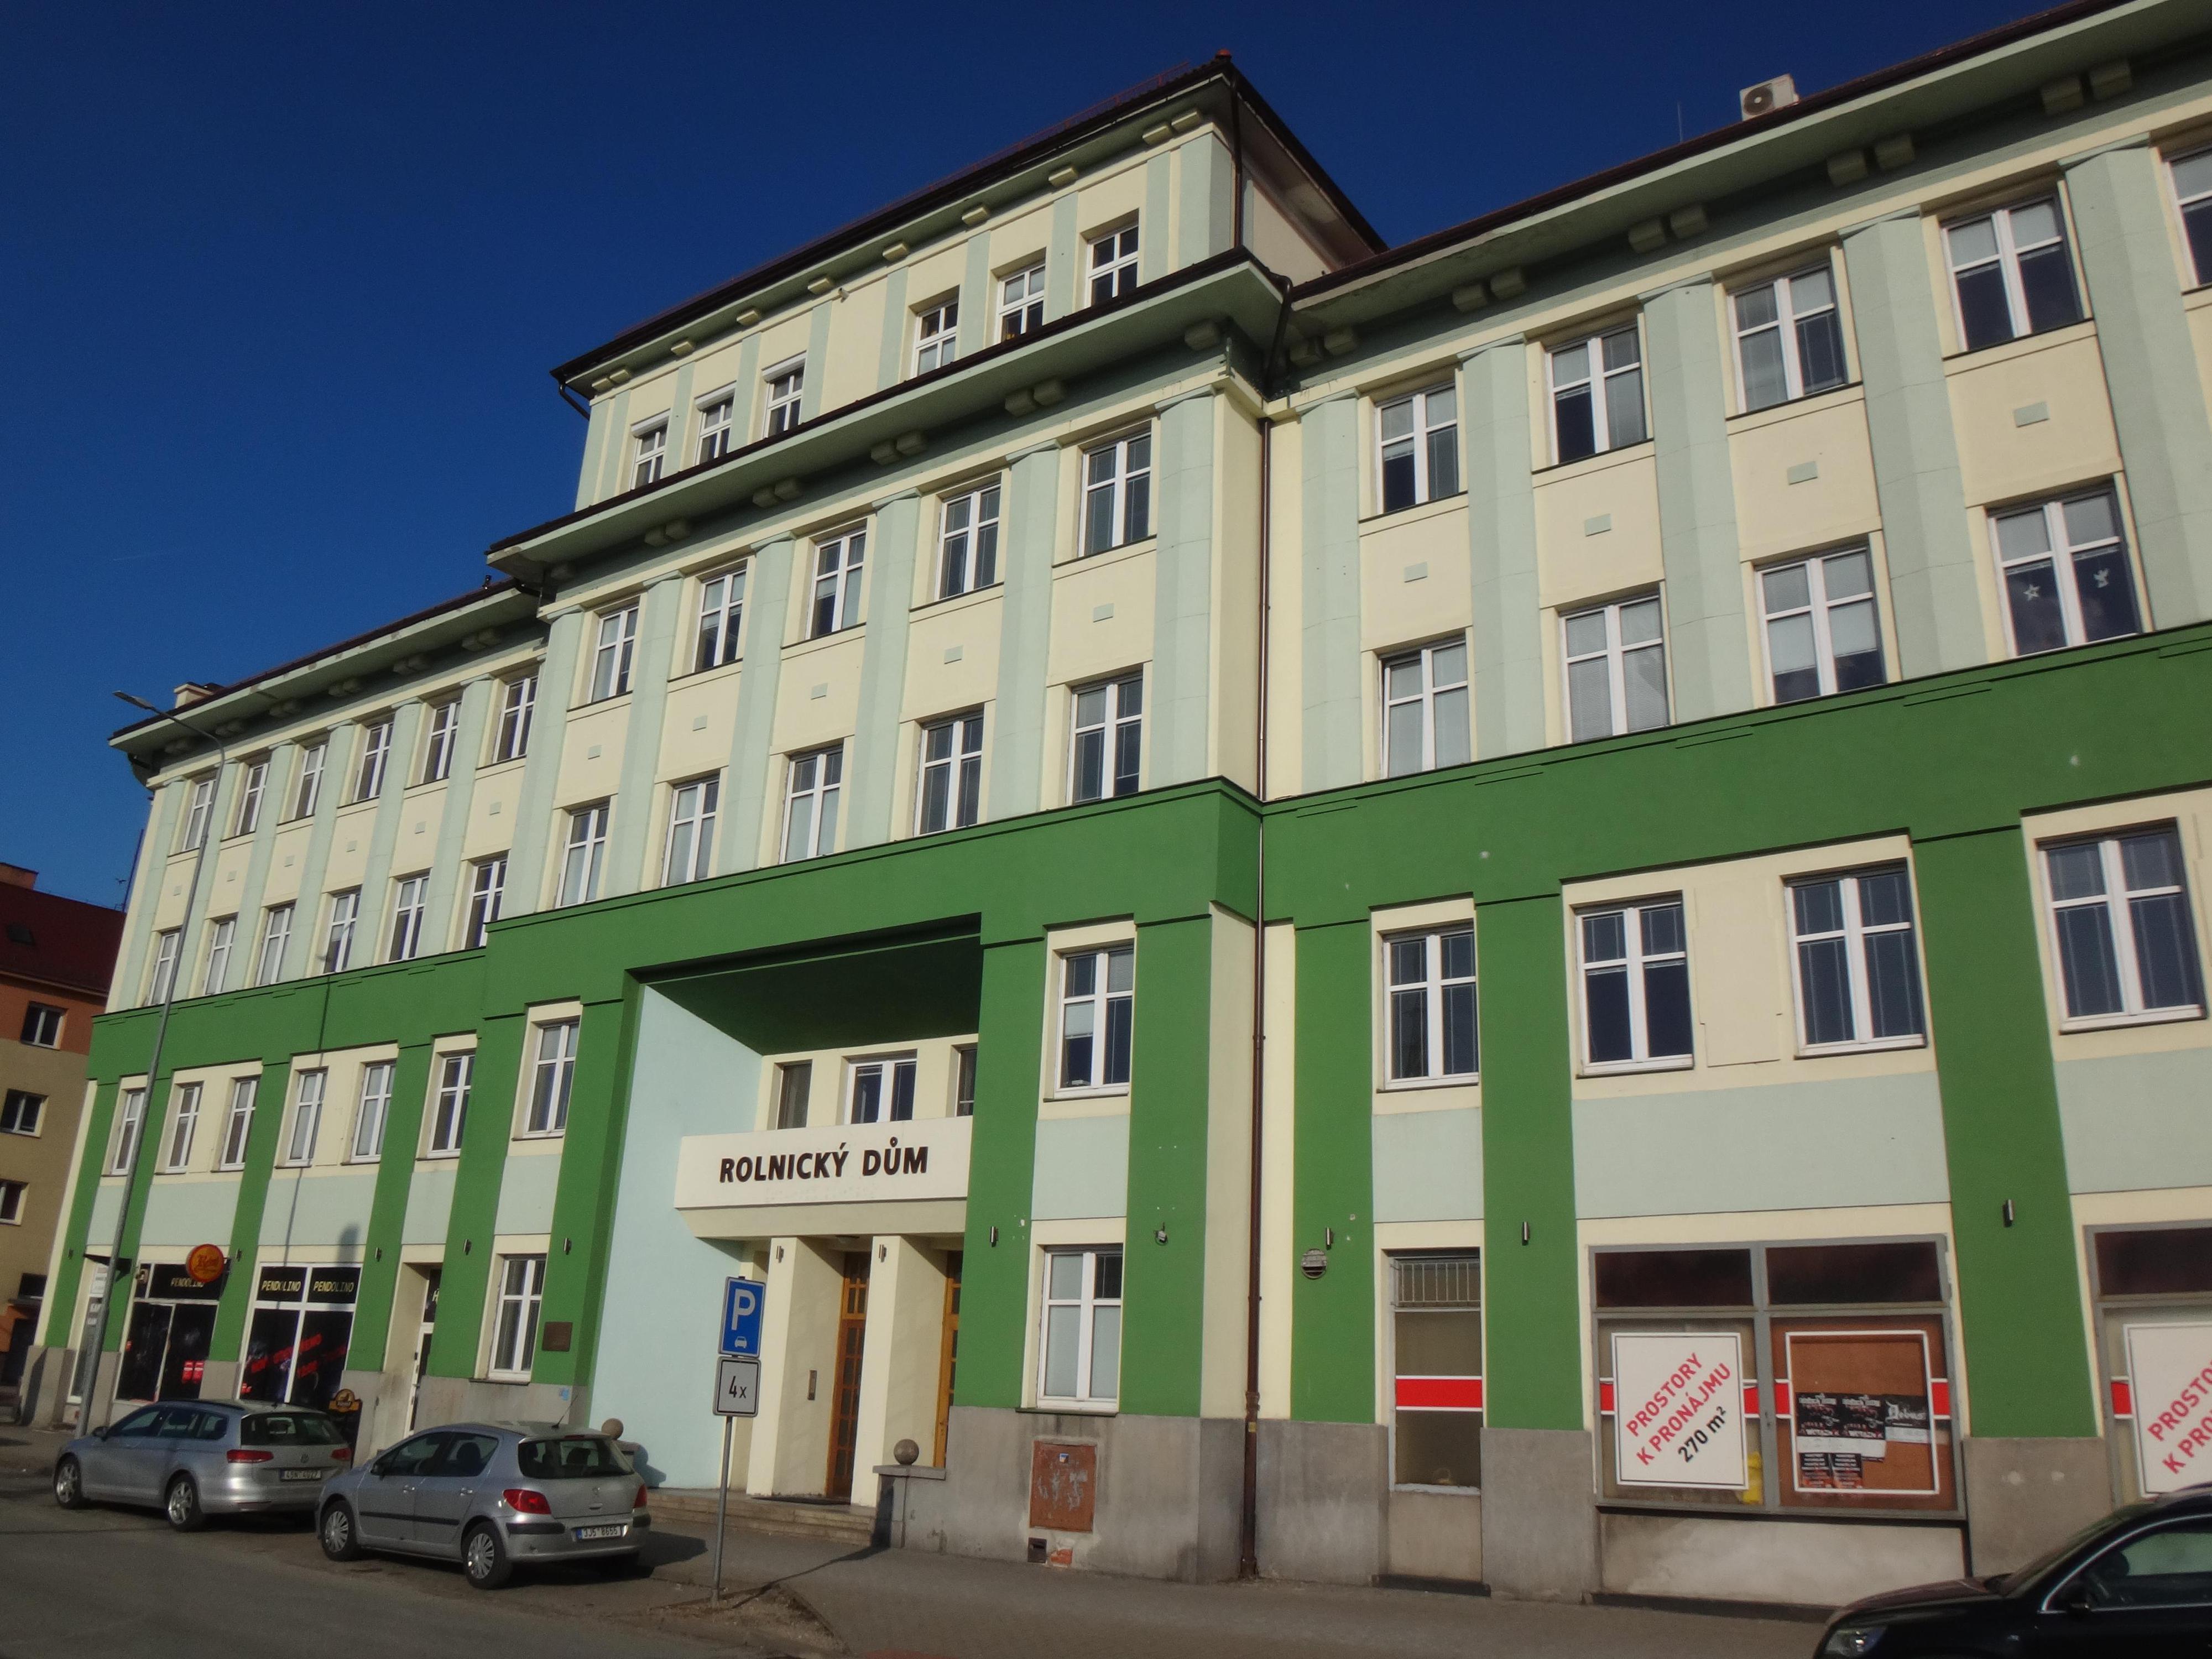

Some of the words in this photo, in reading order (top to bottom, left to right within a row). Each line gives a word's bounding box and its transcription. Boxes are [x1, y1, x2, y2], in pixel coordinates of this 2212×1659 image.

[719, 1142, 849, 1183] ROLNICKÝ
[862, 1136, 928, 1176] DŮM
[262, 1280, 301, 1292] PENDOLINO
[314, 1281, 354, 1292] PENDOLINO
[731, 1288, 756, 1331] P
[728, 1375, 747, 1399] 4x
[1626, 1353, 1702, 1437] PROSTORY
[2147, 1360, 2212, 1441] PROSTO
[1636, 1446, 1655, 1465] K
[1648, 1363, 1730, 1452] PRONÁJMU
[1678, 1429, 1708, 1463] 270
[2162, 1452, 2185, 1474] K
[2178, 1409, 2212, 1458] PRO
